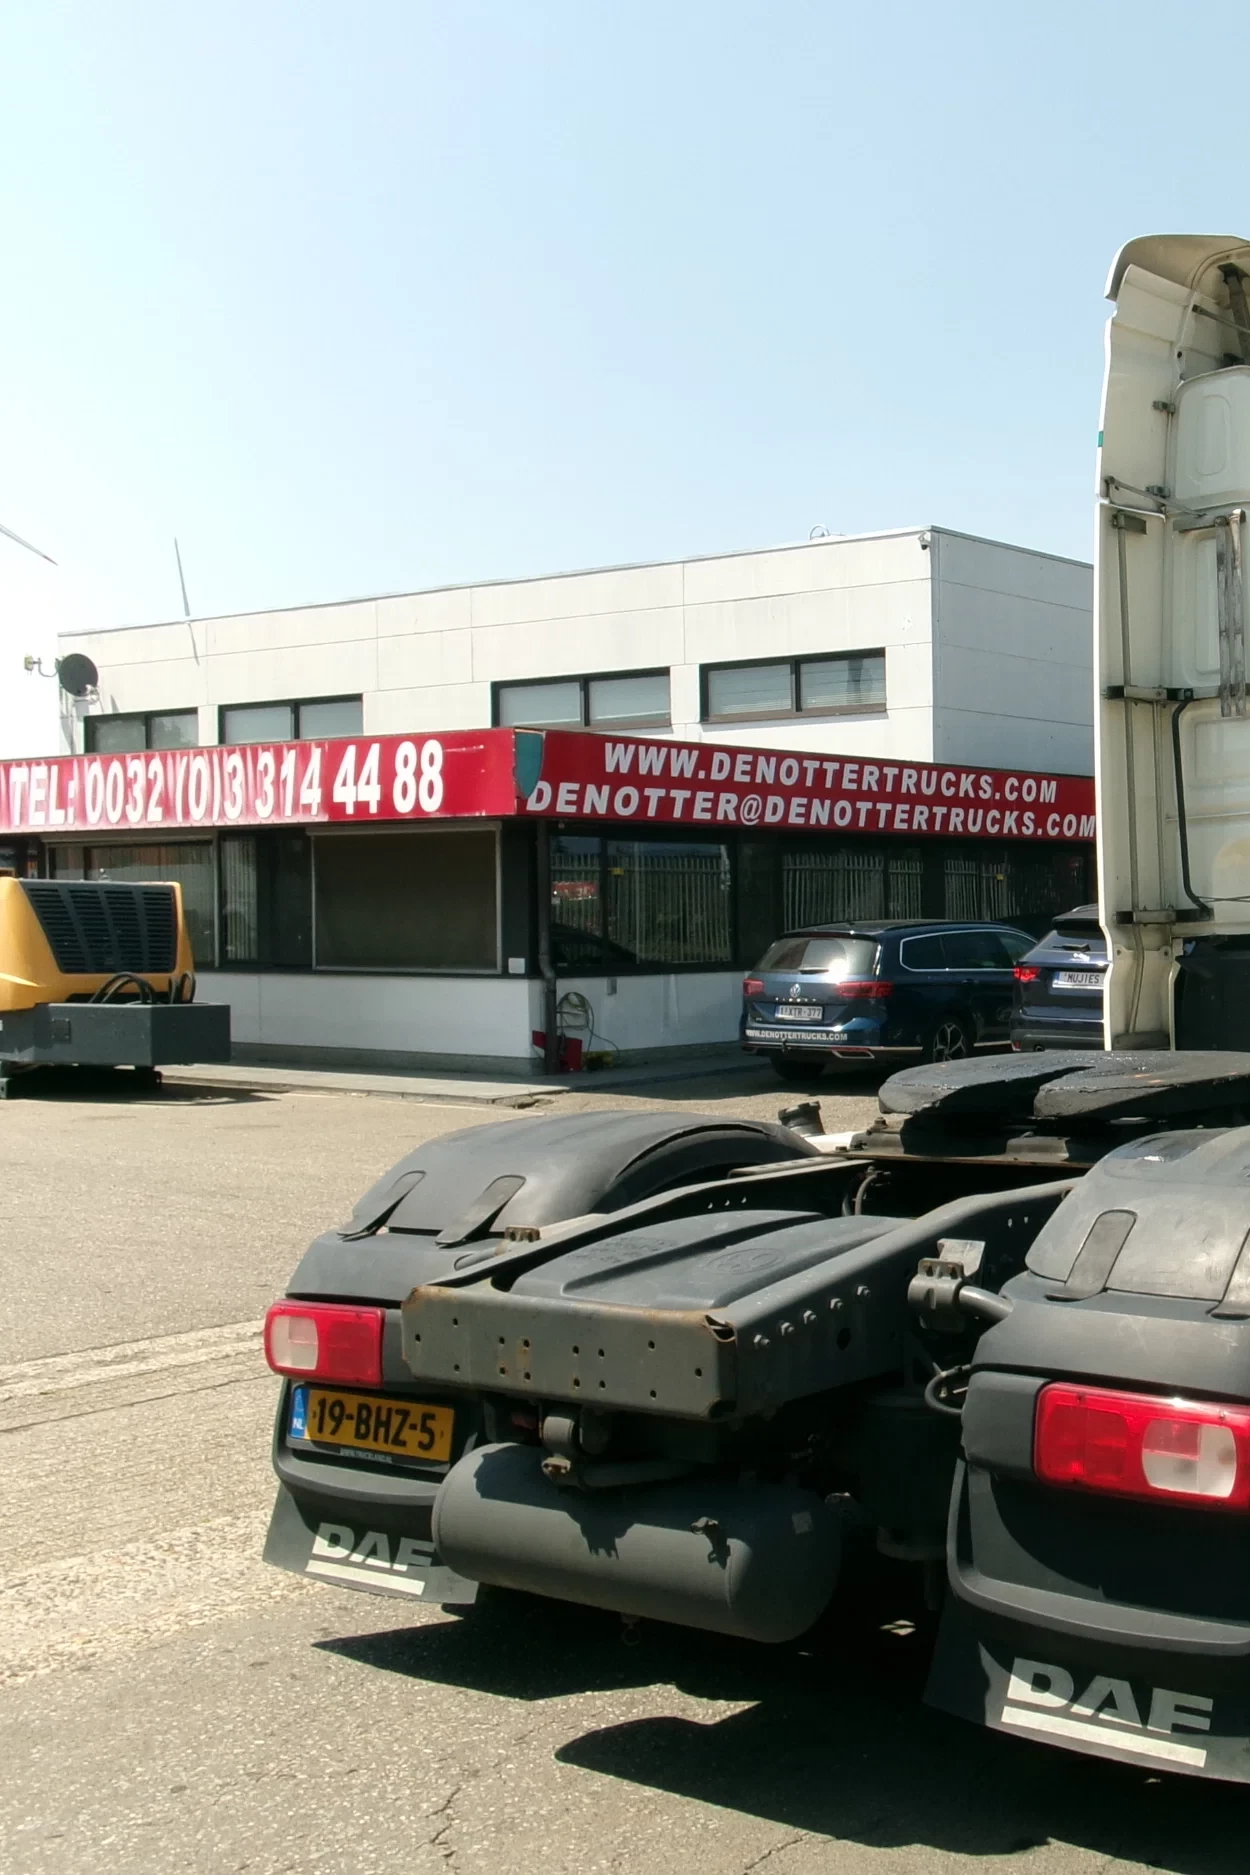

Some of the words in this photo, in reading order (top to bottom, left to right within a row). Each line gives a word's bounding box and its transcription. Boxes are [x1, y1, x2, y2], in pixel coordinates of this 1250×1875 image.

[9, 763, 76, 827] TEL:
[85, 756, 164, 825] 0032
[255, 748, 322, 819] 314
[333, 743, 381, 815] 44
[392, 739, 443, 814] 88
[604, 742, 1057, 804] WWW.DENOTTERTRUCKS.COM
[526, 780, 1095, 838] DENOTTER@DENOTTERTRUCKS.COM
[292, 1417, 305, 1431] NL
[316, 1398, 437, 1451] 19-BHZ-5
[312, 1522, 436, 1572] DAF
[1007, 1657, 1214, 1734] DAF
